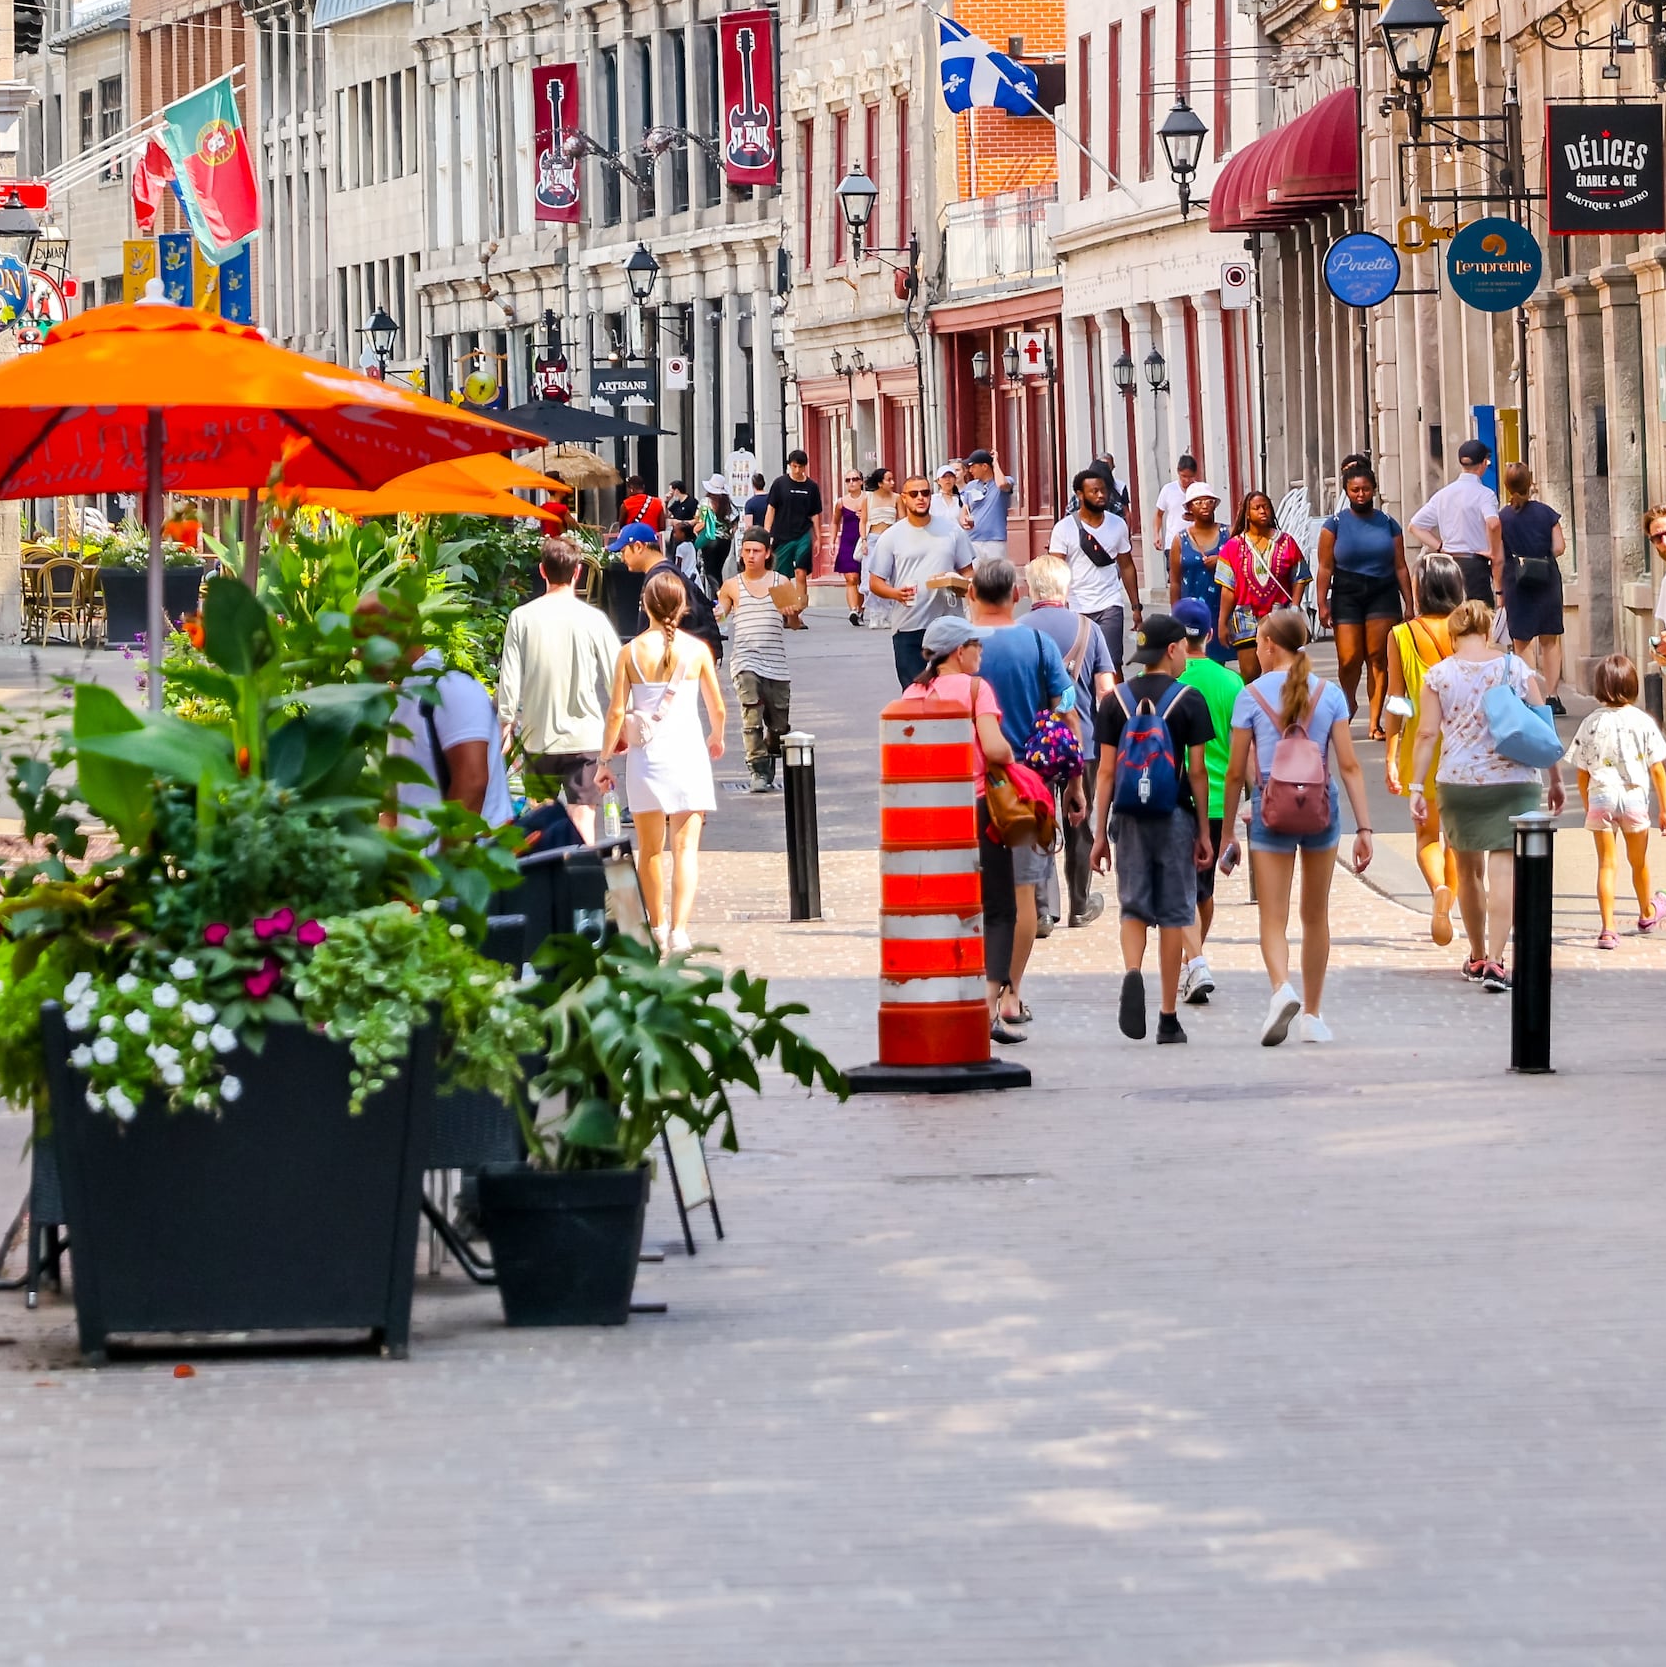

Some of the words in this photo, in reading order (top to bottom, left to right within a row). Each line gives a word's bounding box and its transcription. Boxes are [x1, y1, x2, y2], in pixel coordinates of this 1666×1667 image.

[1564, 134, 1648, 171] DÉLICES
[1576, 172, 1607, 187] ÉRABLE
[1623, 174, 1637, 187] CIE
[1565, 191, 1611, 211] BOUTIQUE
[1619, 190, 1649, 208] BISTRO
[1329, 252, 1394, 274] Pincette
[597, 381, 647, 392] ARTISANS
